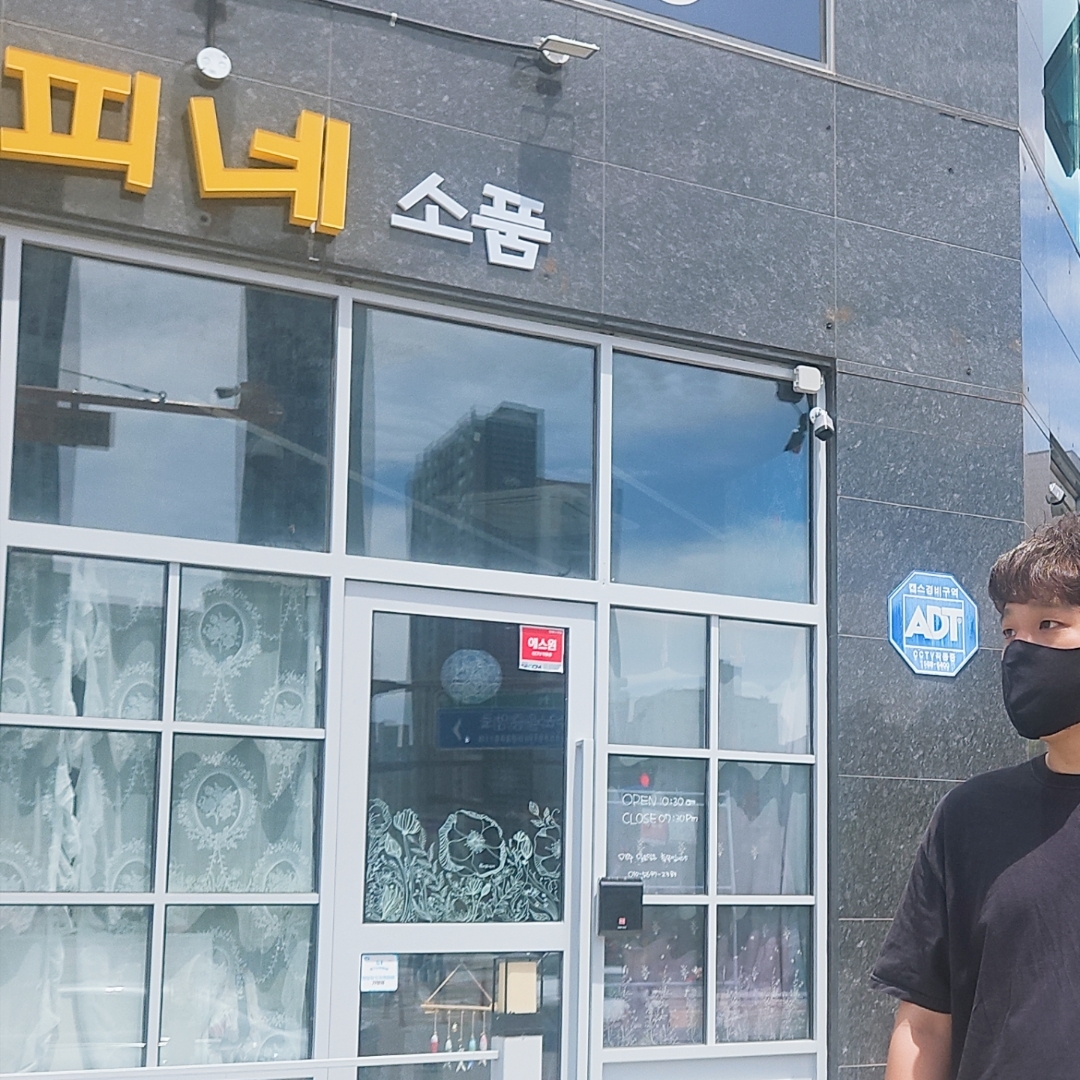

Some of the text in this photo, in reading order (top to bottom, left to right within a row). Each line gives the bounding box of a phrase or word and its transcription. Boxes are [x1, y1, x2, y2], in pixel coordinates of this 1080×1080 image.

[390, 171, 552, 271] 소품
[905, 604, 963, 642] ADT
[527, 636, 558, 652] 에스원
[622, 793, 657, 807] OPEN
[622, 812, 657, 825] CLOSE
